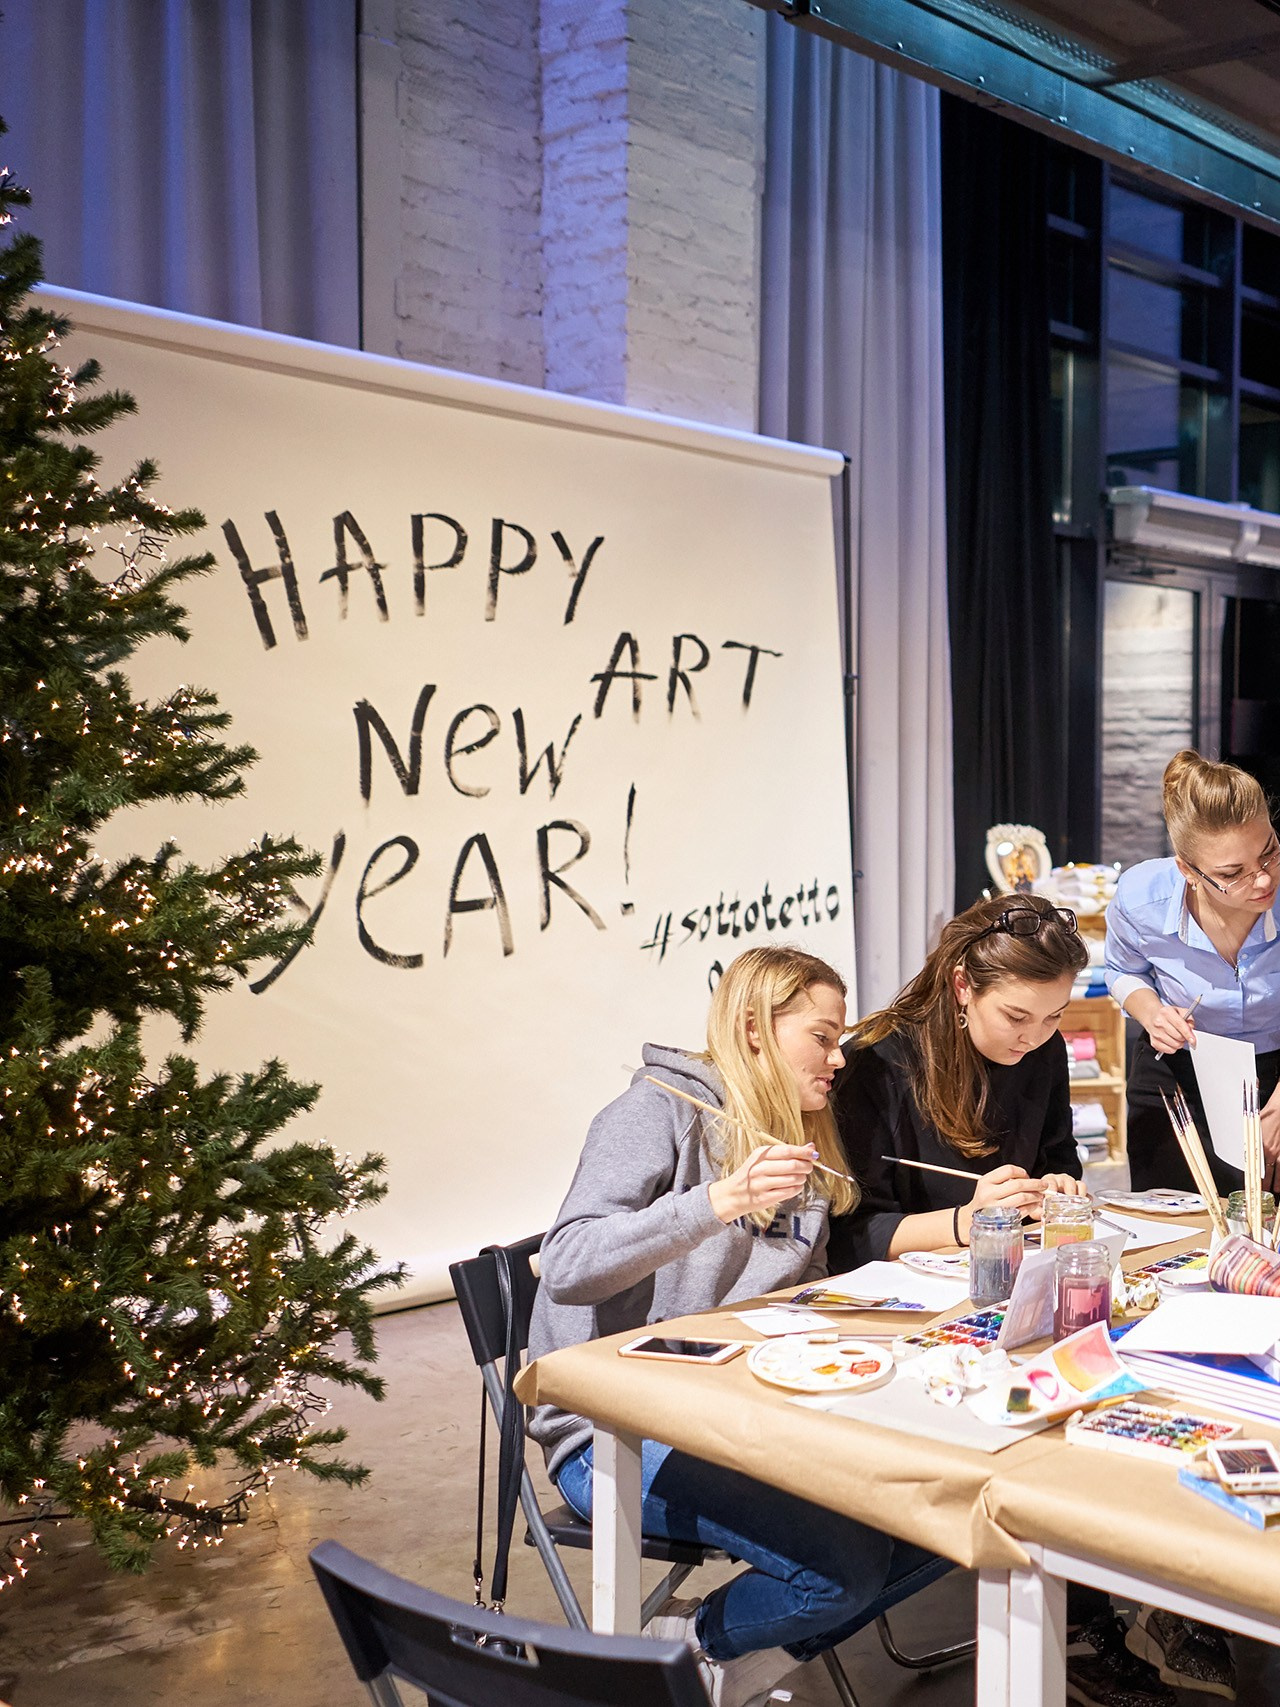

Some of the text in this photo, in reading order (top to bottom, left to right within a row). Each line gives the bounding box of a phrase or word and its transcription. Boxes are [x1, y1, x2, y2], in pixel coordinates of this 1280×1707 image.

[220, 509, 605, 650] HAPPY
[589, 631, 783, 724] ART
[640, 877, 840, 964] #sottotetto
